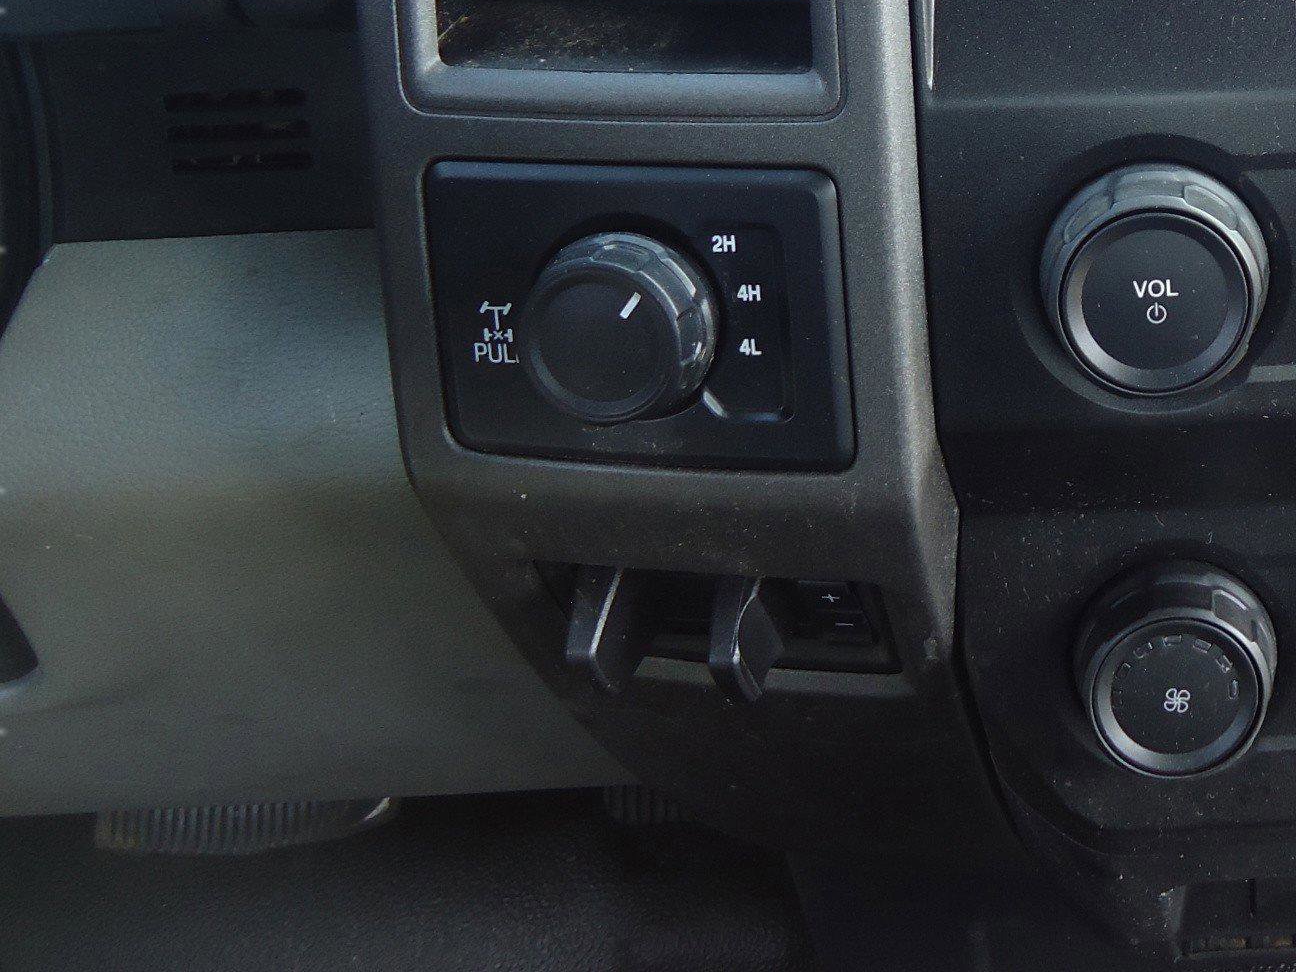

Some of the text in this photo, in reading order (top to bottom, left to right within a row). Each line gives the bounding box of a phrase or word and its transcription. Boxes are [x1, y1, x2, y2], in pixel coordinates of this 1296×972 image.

[711, 234, 736, 253] 2H
[736, 284, 762, 302] 4H
[1132, 278, 1179, 299] VOL
[473, 342, 520, 364] PUL
[739, 338, 762, 356] 4L
